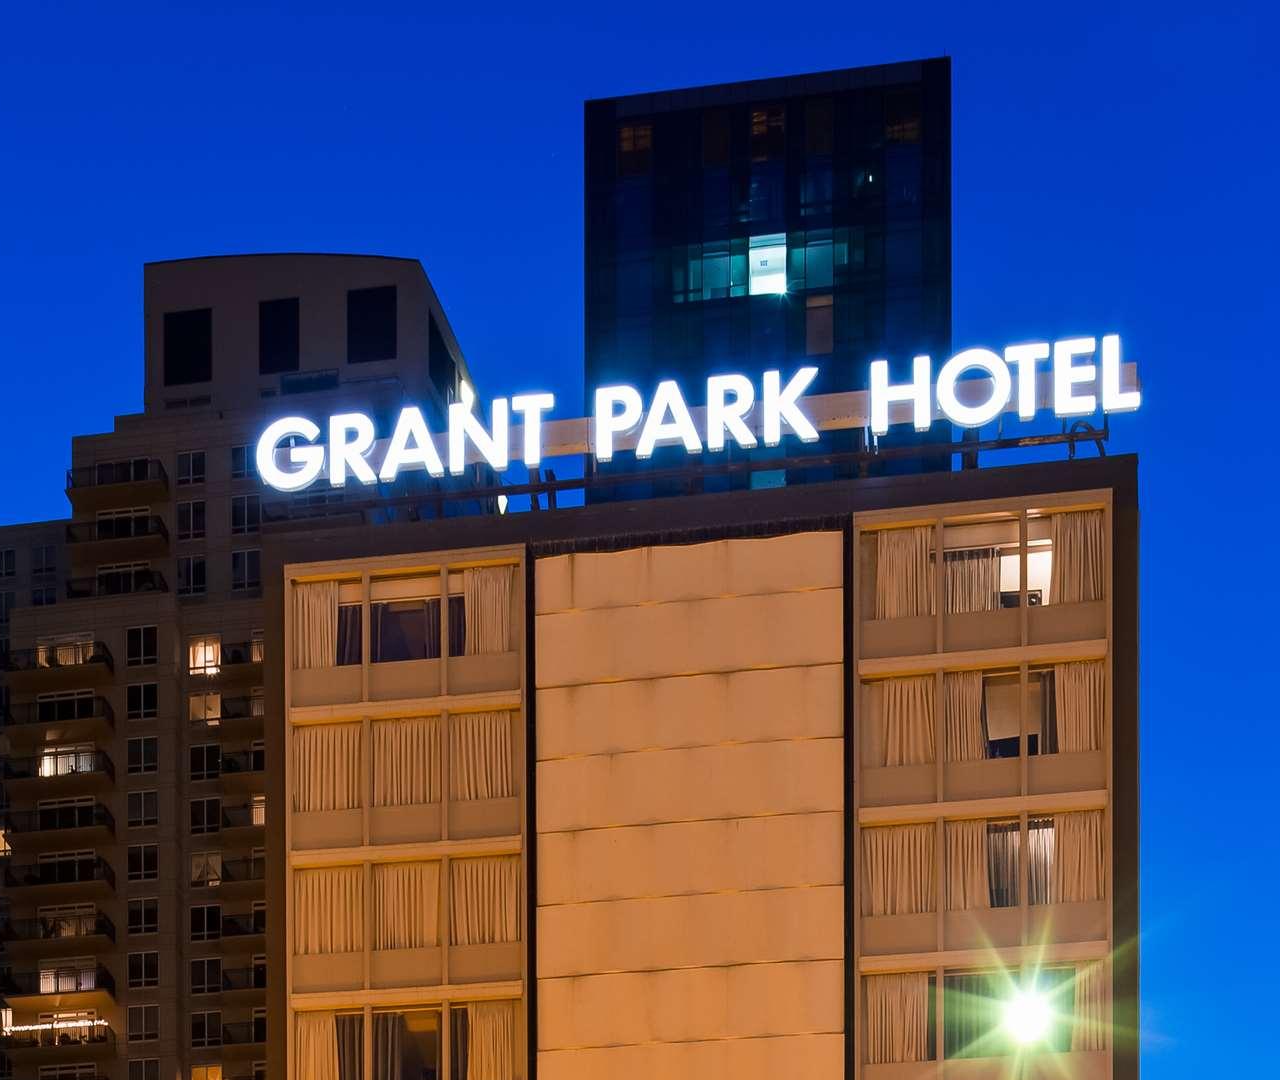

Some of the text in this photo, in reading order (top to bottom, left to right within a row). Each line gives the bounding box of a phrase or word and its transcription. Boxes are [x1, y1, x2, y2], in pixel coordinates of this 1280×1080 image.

[256, 334, 1141, 492] GRANT PARK HOTEL
